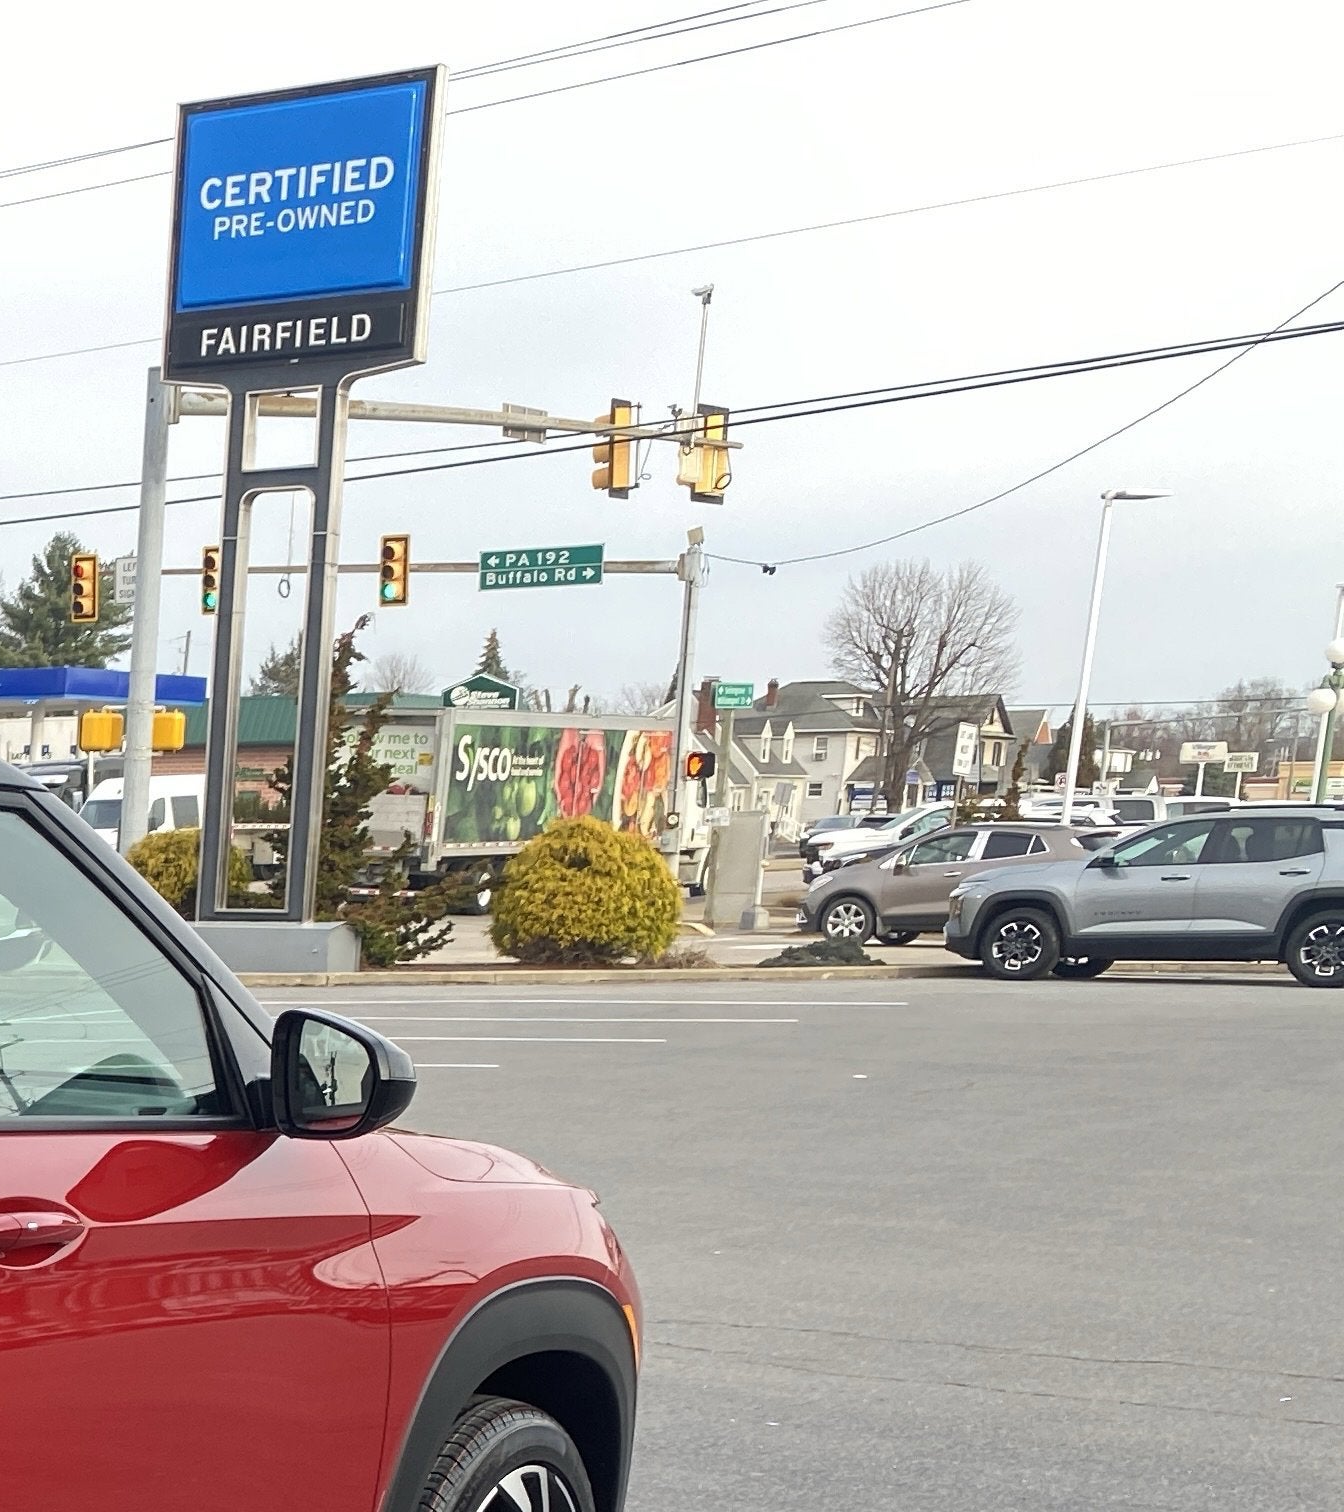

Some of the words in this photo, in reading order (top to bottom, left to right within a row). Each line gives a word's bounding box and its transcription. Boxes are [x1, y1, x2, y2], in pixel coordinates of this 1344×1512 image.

[200, 155, 395, 211] CERTIFIED
[213, 198, 376, 240] PRE-OWNED
[200, 312, 372, 357] FAIRFIELD
[505, 553, 530, 567] PA
[536, 550, 570, 565] 192
[485, 569, 548, 585] Buffalo
[554, 567, 577, 581] Rd
[387, 733, 411, 745] me
[414, 732, 429, 745] to
[383, 747, 416, 759] next
